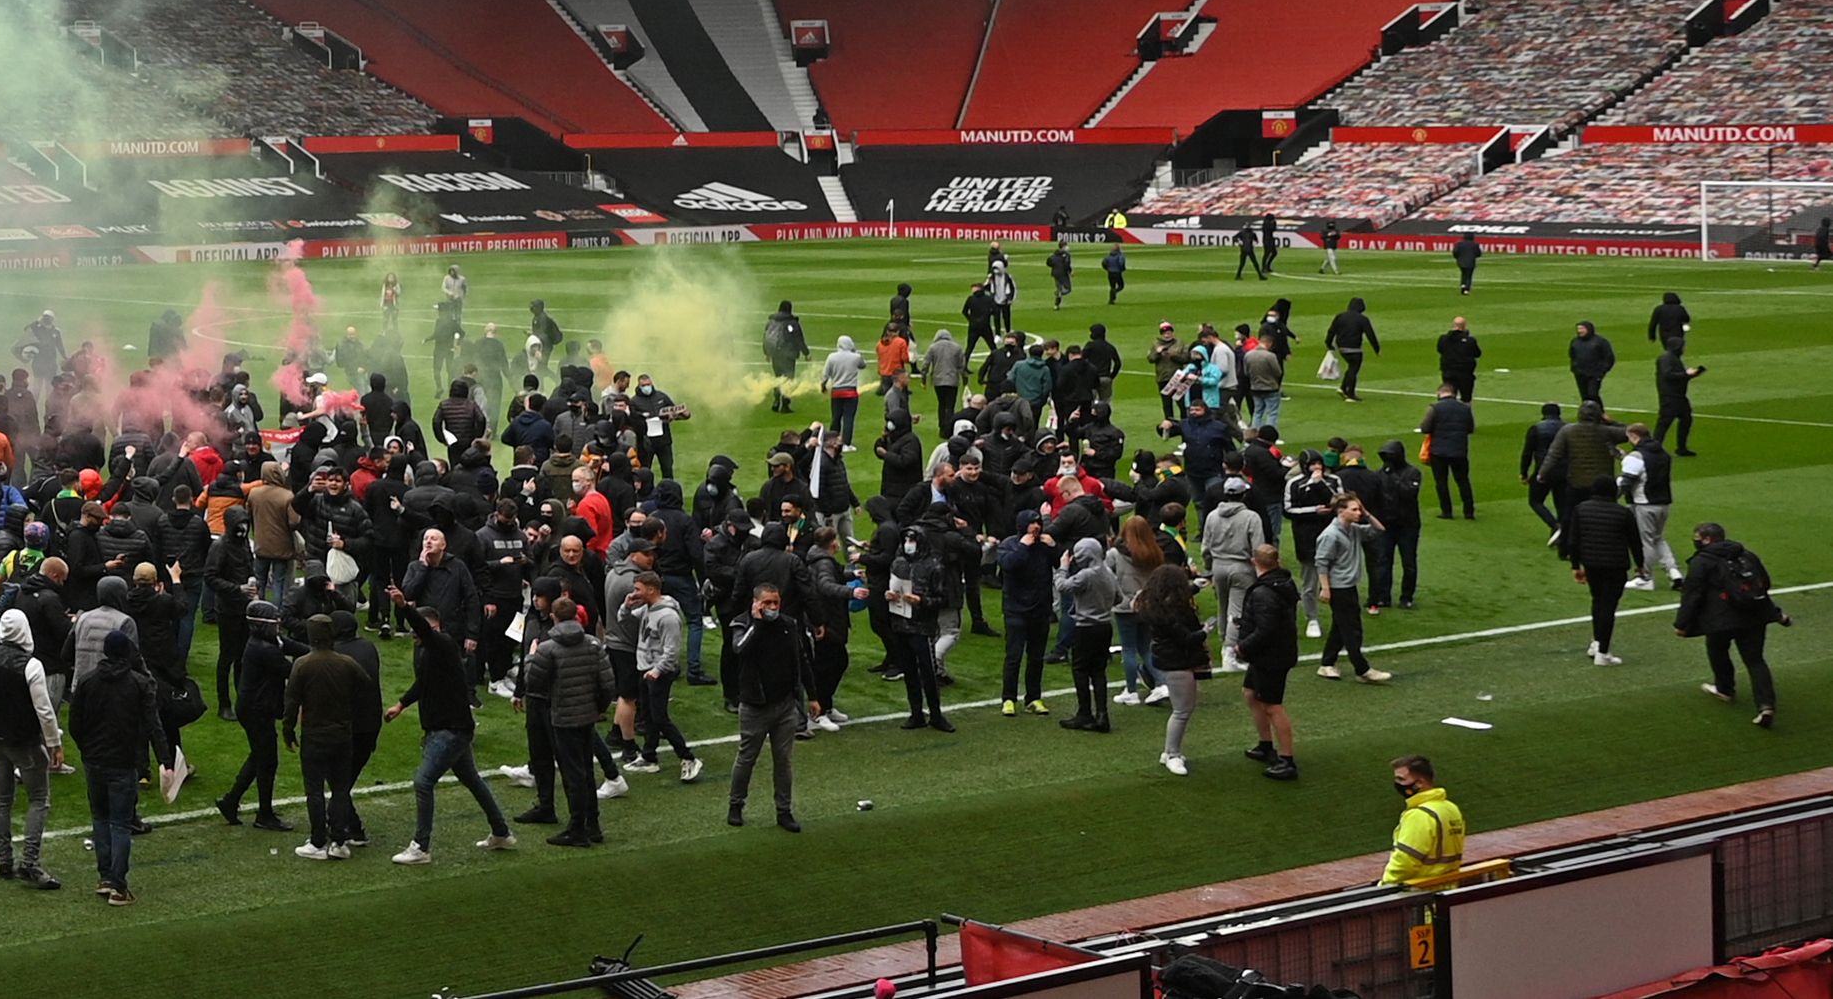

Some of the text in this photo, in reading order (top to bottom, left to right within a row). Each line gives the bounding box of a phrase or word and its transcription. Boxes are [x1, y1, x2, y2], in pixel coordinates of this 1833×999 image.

[960, 129, 1074, 143] MANUTD.COM
[1653, 126, 1795, 142] MANUTD.COM
[110, 140, 199, 155] MANUTD.COM
[148, 176, 314, 198] AGAINST
[378, 171, 532, 193] RACISM
[948, 176, 1054, 191] UNITED
[931, 186, 1054, 202] FOR THE
[673, 199, 808, 212] adidas
[924, 198, 1040, 213] HEROES
[777, 226, 1040, 241] PLAY AND WIN WITH UNITED PREDICTIONS
[1447, 224, 1530, 234] KOHLER
[671, 230, 741, 244] OFFICIAL APP
[1189, 235, 1291, 249] OFFIC PP
[196, 247, 279, 262] OFFICIAL APP
[322, 237, 559, 258] PLAY AND WIN WITH UNITED PREDICTIONS
[1348, 239, 1387, 250] PLAY
[1394, 241, 1426, 251] AND
[1433, 242, 1455, 252] WI
[1525, 244, 1588, 256] UNITED
[1417, 940, 1430, 965] 2
